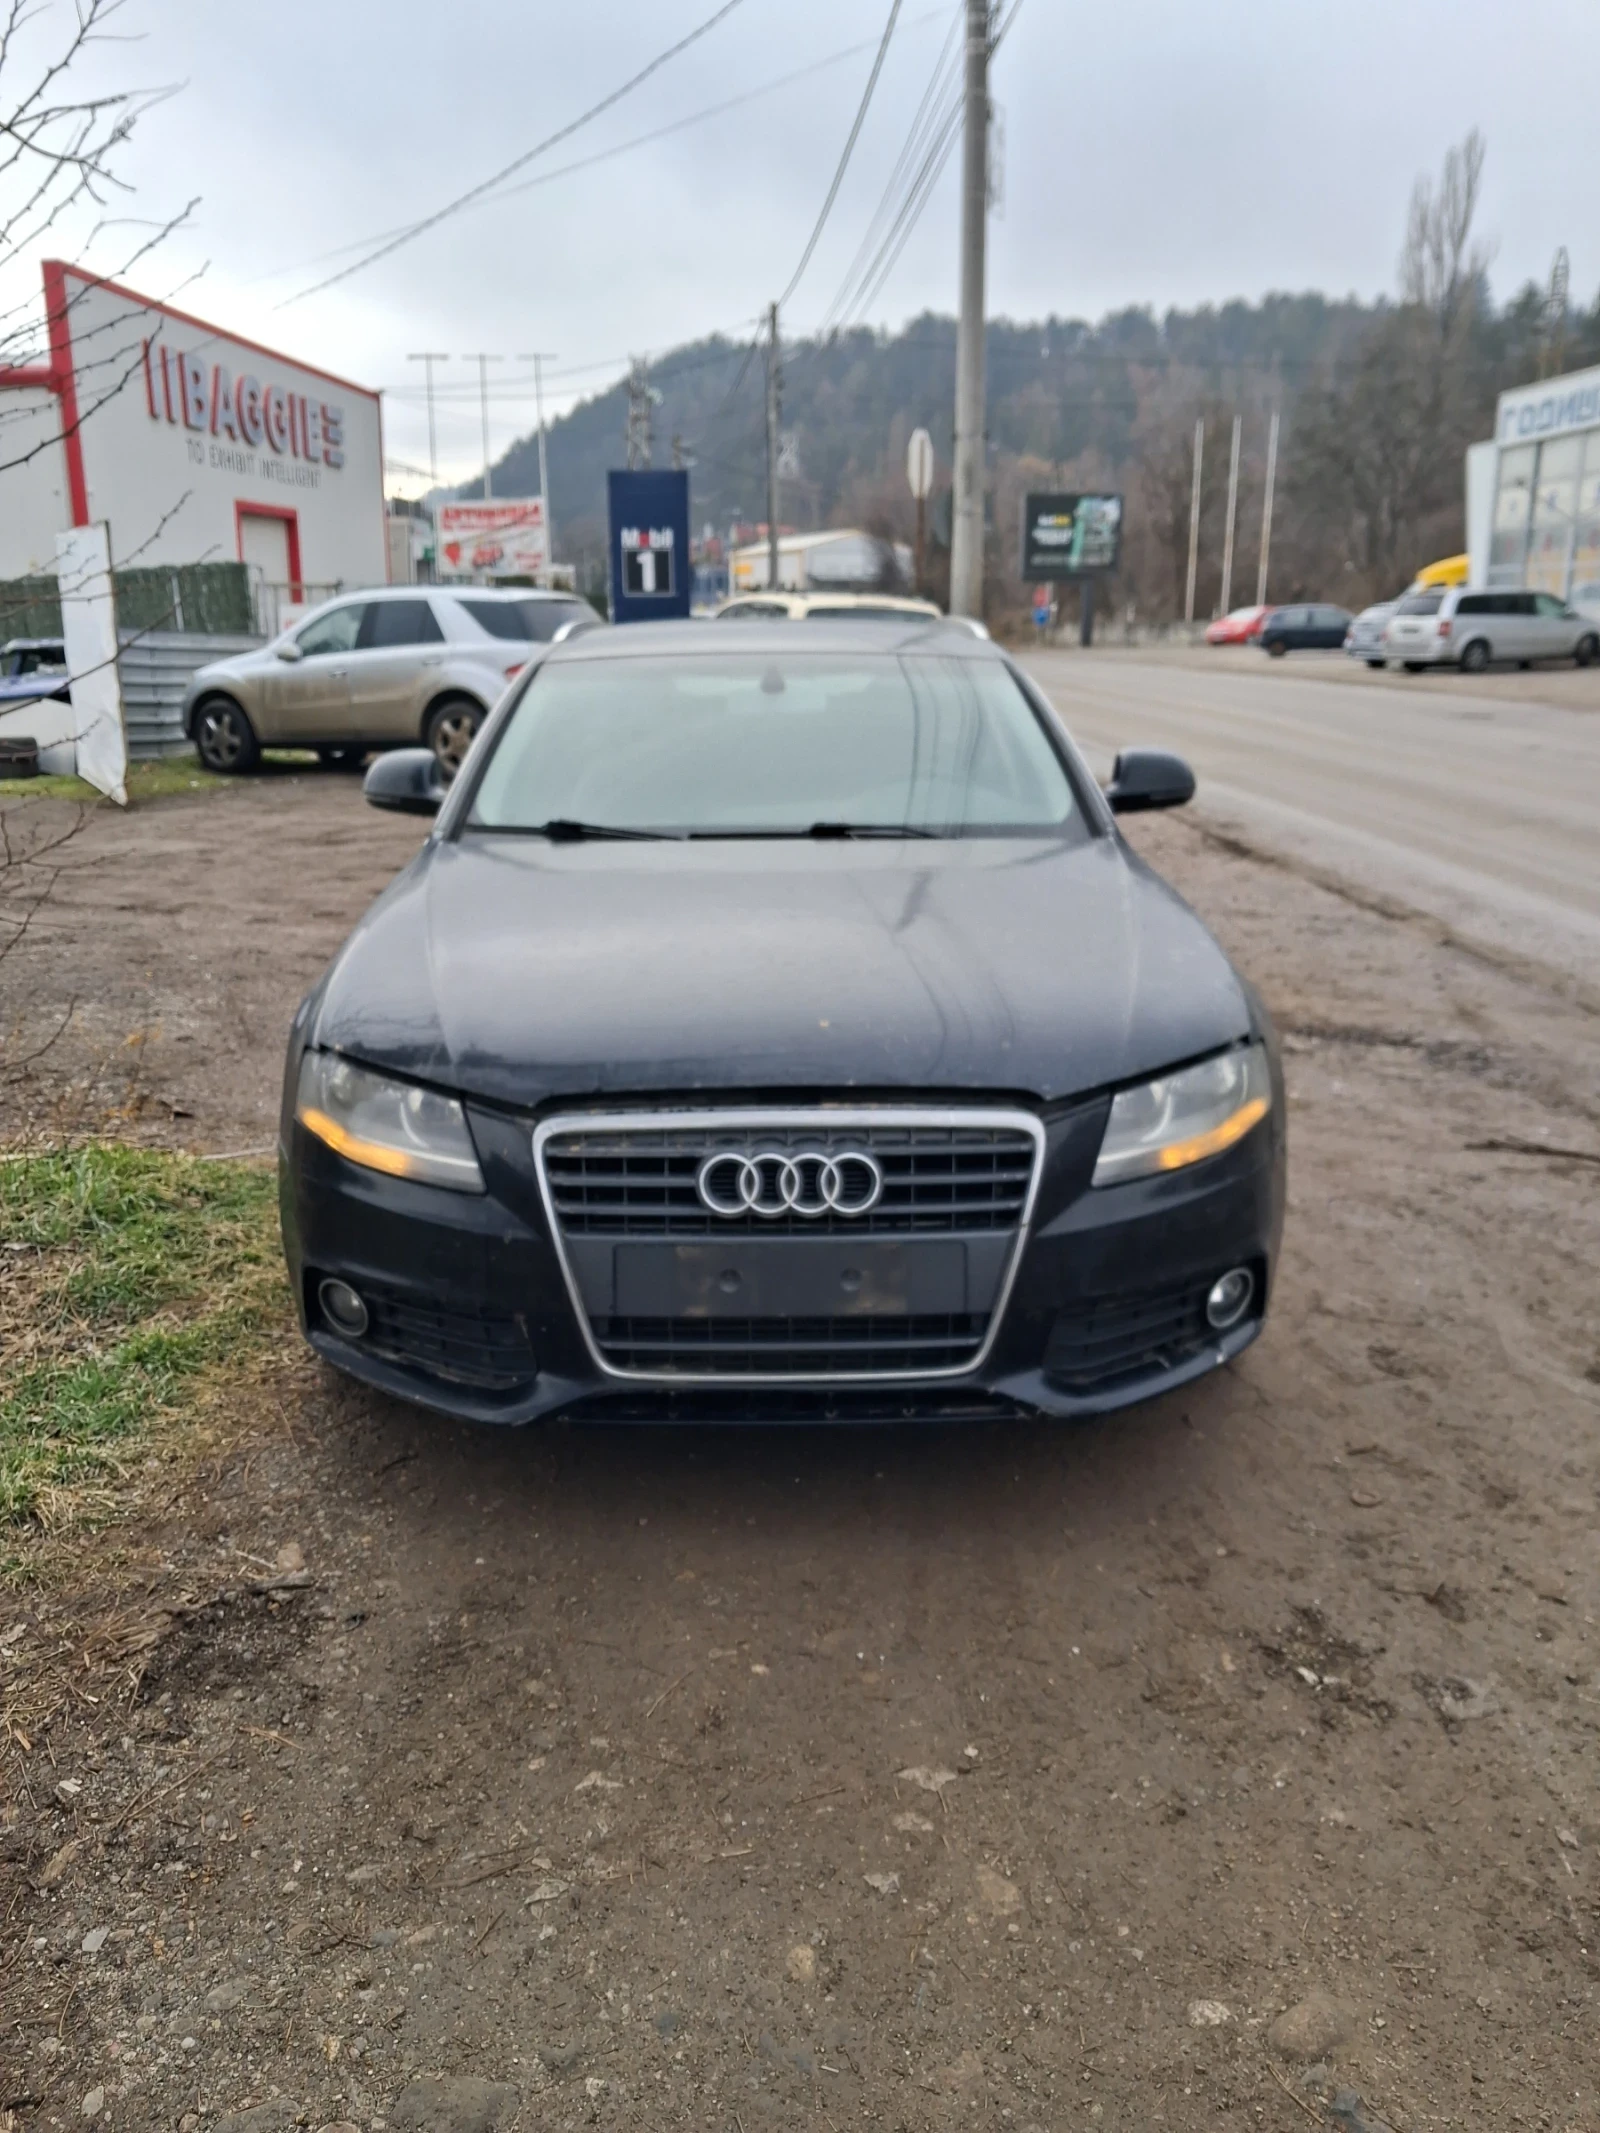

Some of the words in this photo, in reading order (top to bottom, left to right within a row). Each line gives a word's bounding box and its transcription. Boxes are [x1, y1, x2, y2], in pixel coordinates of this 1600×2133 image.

[186, 438, 205, 465] TO
[209, 444, 255, 475] EXHIBIT
[620, 527, 675, 549] Mobil
[635, 551, 657, 592] 1
